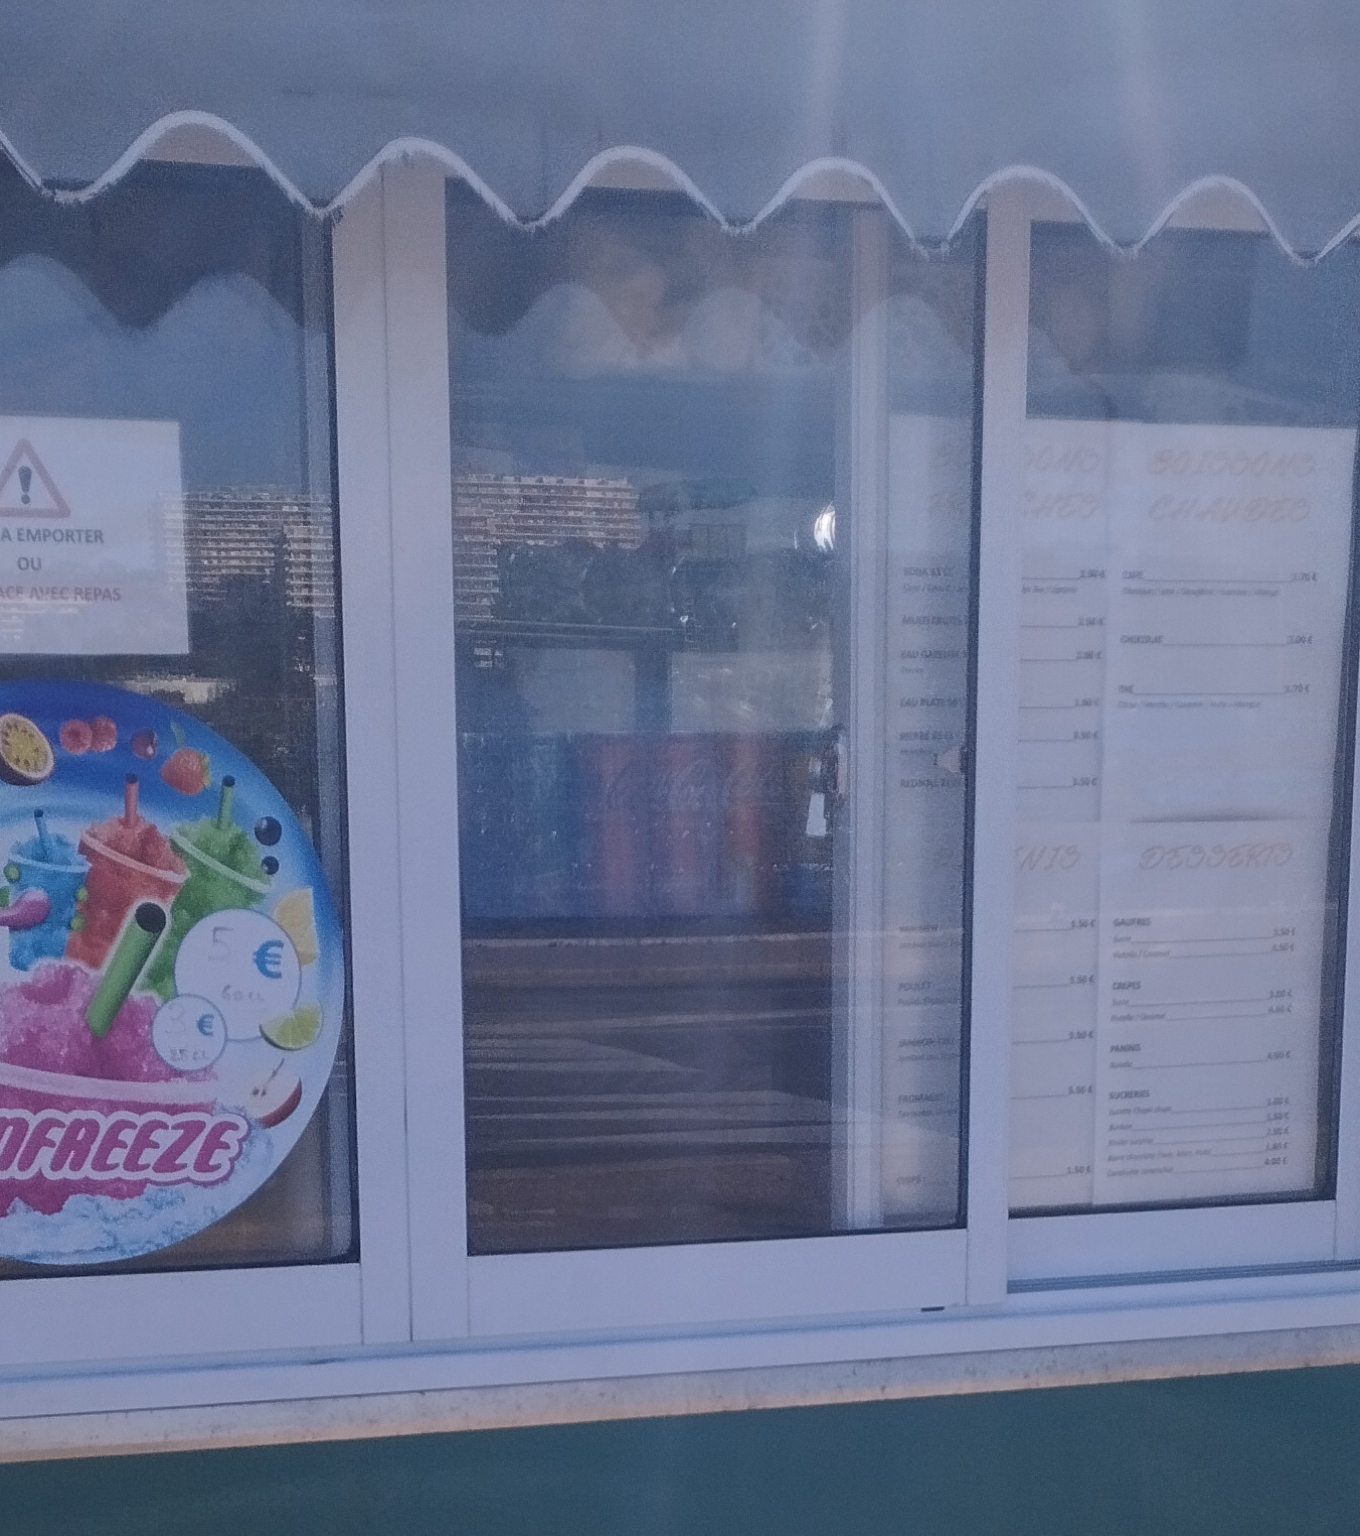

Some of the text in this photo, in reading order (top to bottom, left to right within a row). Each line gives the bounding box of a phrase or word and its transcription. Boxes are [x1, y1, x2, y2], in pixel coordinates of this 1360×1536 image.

[1146, 449, 1317, 478] BOISSONS
[1148, 495, 1312, 523] CHAUDES
[0, 526, 13, 542] A
[16, 527, 105, 545] EMPORTER
[17, 555, 42, 572] OU
[29, 584, 70, 601] AVEC
[73, 585, 122, 602] REPAS
[1139, 843, 1294, 872] DESSERTS
[207, 926, 284, 979] 5 €
[196, 1013, 214, 1037] €
[1108, 1089, 1151, 1100] SUCRERIES
